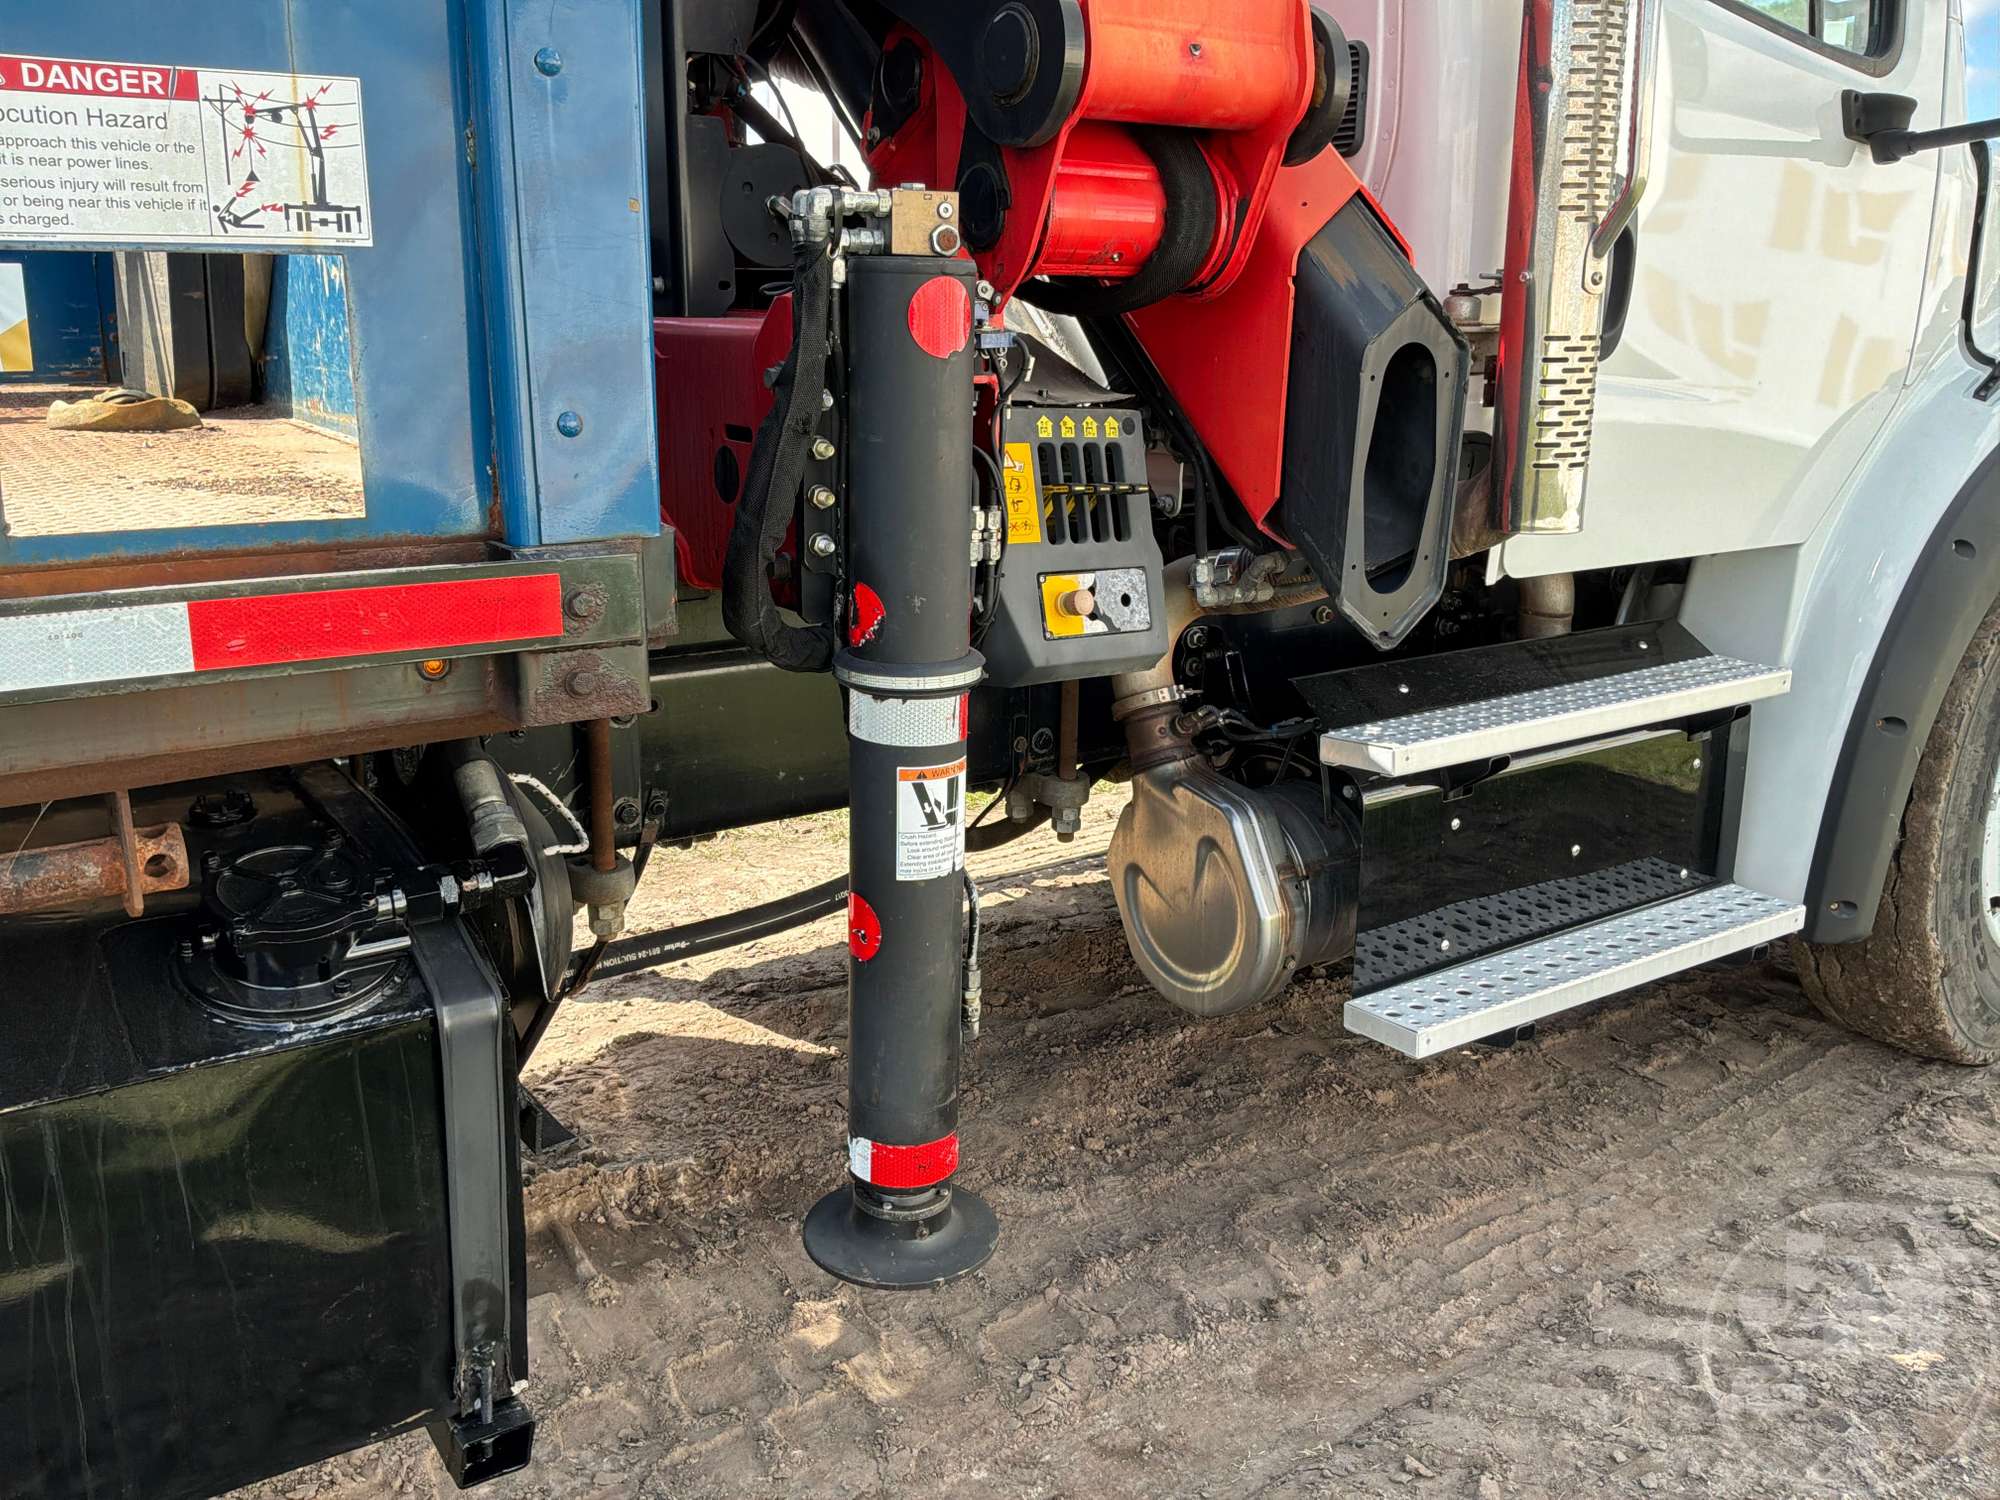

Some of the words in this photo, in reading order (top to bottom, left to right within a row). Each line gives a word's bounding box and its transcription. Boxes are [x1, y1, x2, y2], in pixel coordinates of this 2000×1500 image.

[20, 62, 165, 96] DANGER
[86, 107, 168, 130] Hazard
[71, 137, 97, 150] this
[101, 138, 151, 153] vehicle
[155, 142, 169, 153] or
[173, 142, 196, 154] the
[11, 154, 24, 166] is
[28, 155, 63, 167] near
[67, 157, 112, 171] power
[115, 157, 153, 171] lines.
[0, 175, 56, 190] serious
[60, 177, 99, 193] injury
[103, 178, 127, 192] will
[130, 180, 170, 193] result
[172, 180, 204, 194] from
[3, 197, 18, 207] or
[23, 195, 64, 211] being
[68, 198, 102, 209] near
[105, 197, 131, 209] this
[134, 198, 184, 211] vehicle
[187, 198, 197, 211] if
[199, 199, 208, 211] it
[9, 213, 75, 229] charged.
[603, 952, 637, 967] SUCTION
